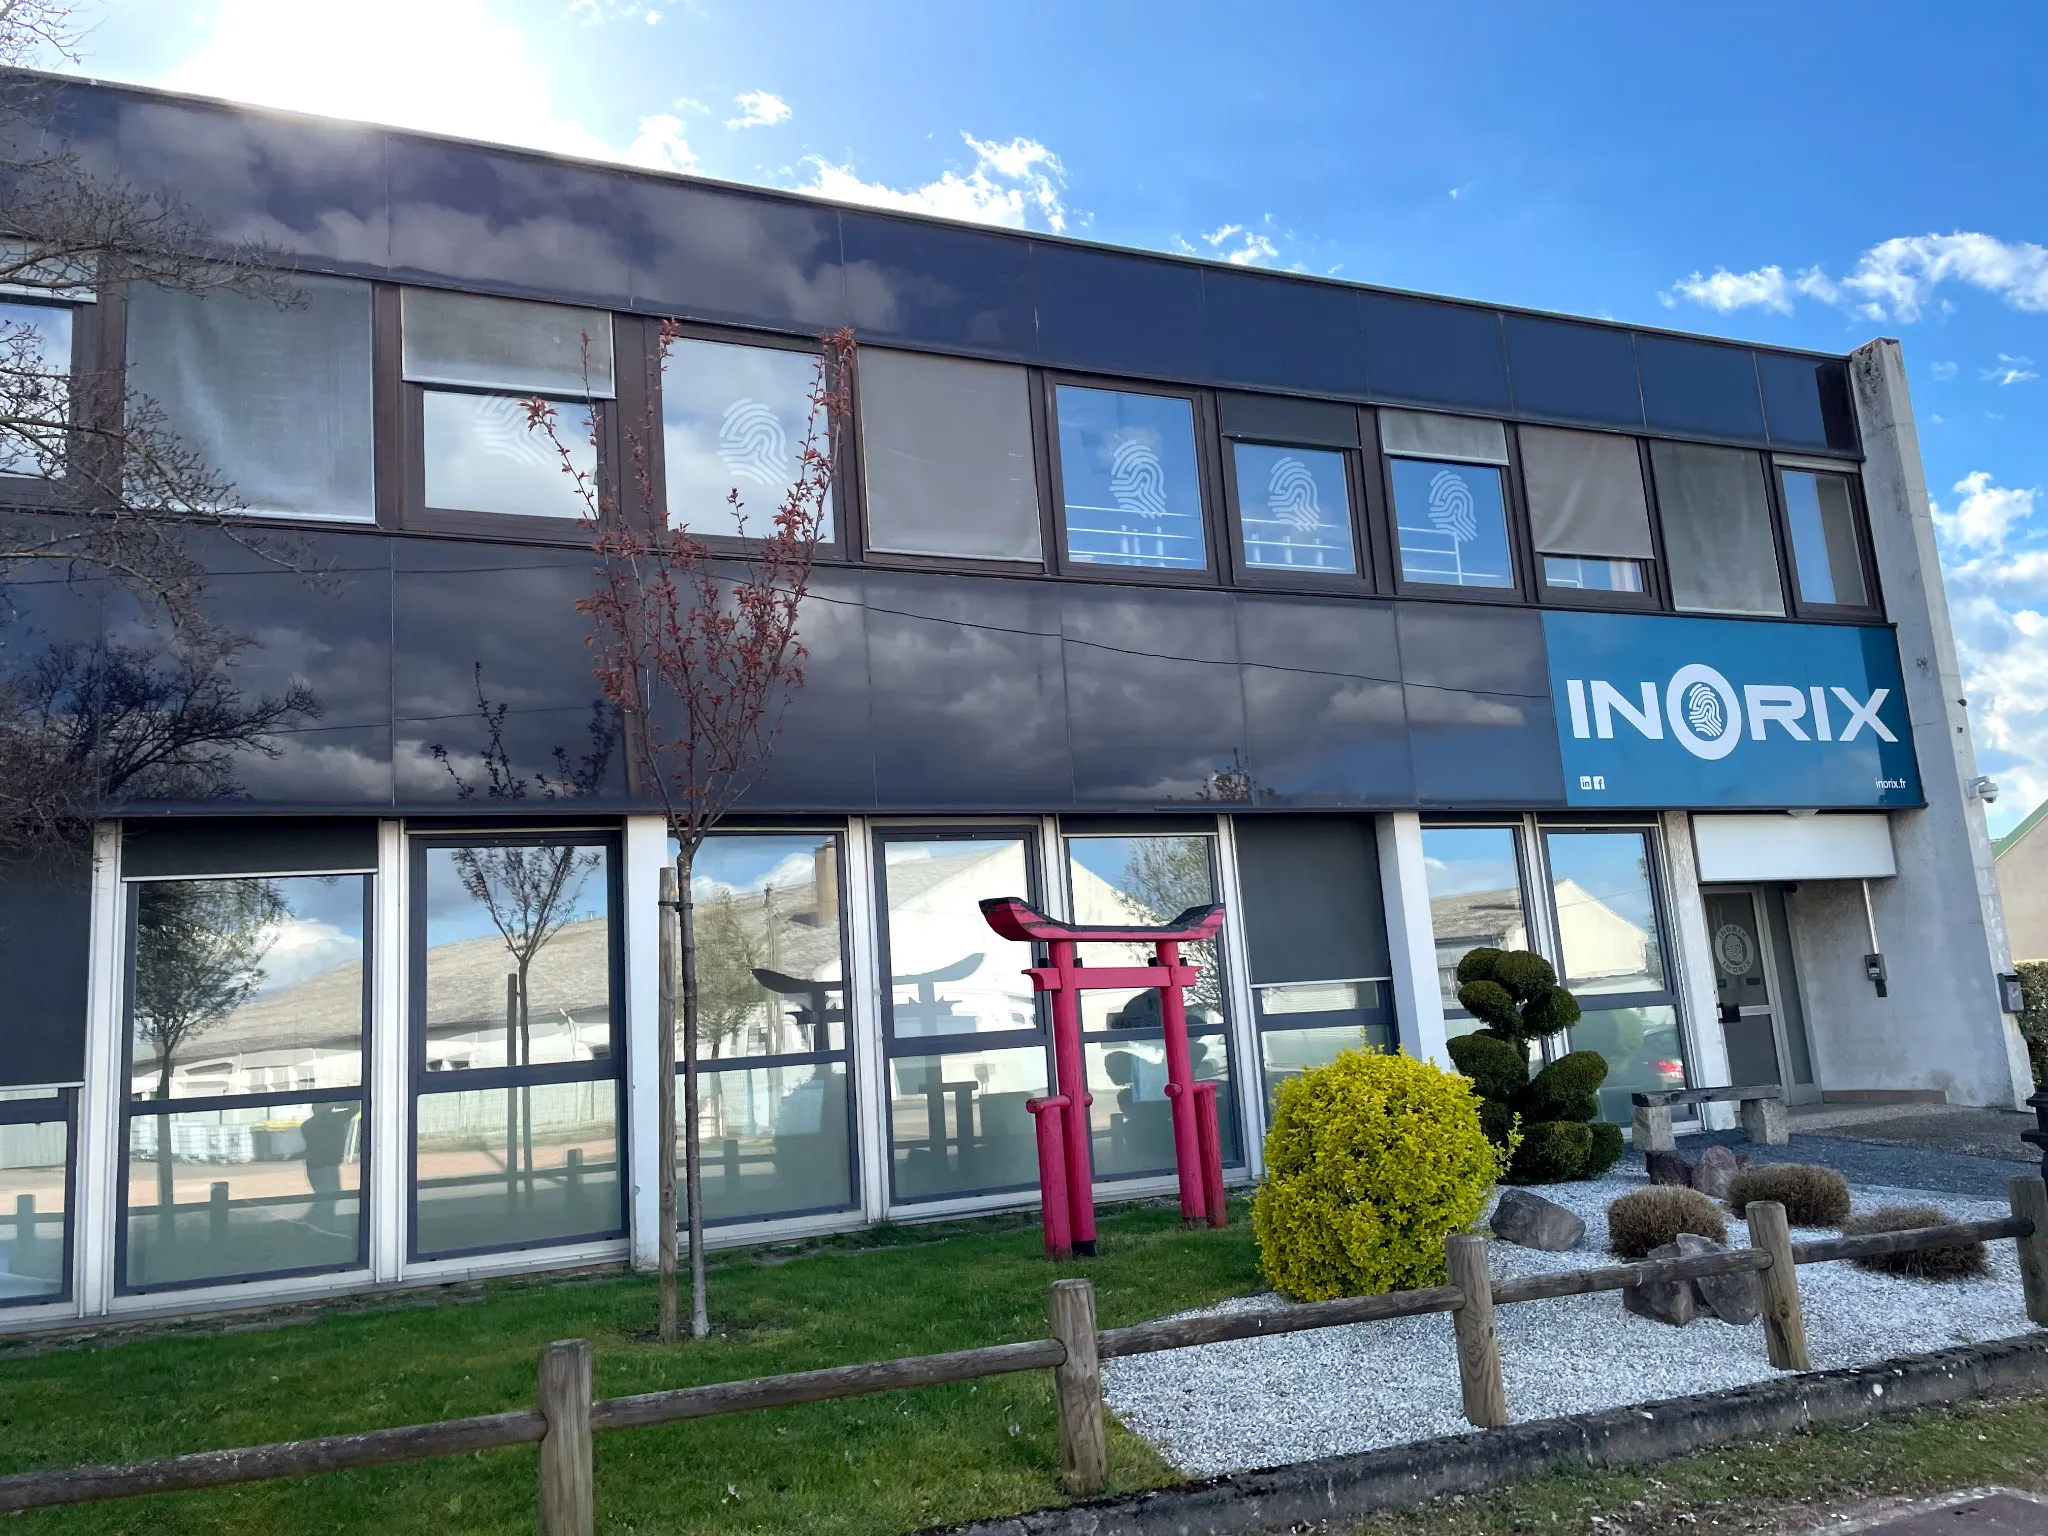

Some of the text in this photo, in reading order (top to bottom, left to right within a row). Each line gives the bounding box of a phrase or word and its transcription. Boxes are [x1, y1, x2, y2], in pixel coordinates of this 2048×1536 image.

[1566, 663, 1899, 760] INORIX
[1875, 778, 1906, 789] inorix.fr
[1718, 926, 1747, 939] INORIX
[1722, 961, 1750, 973] INORIX
